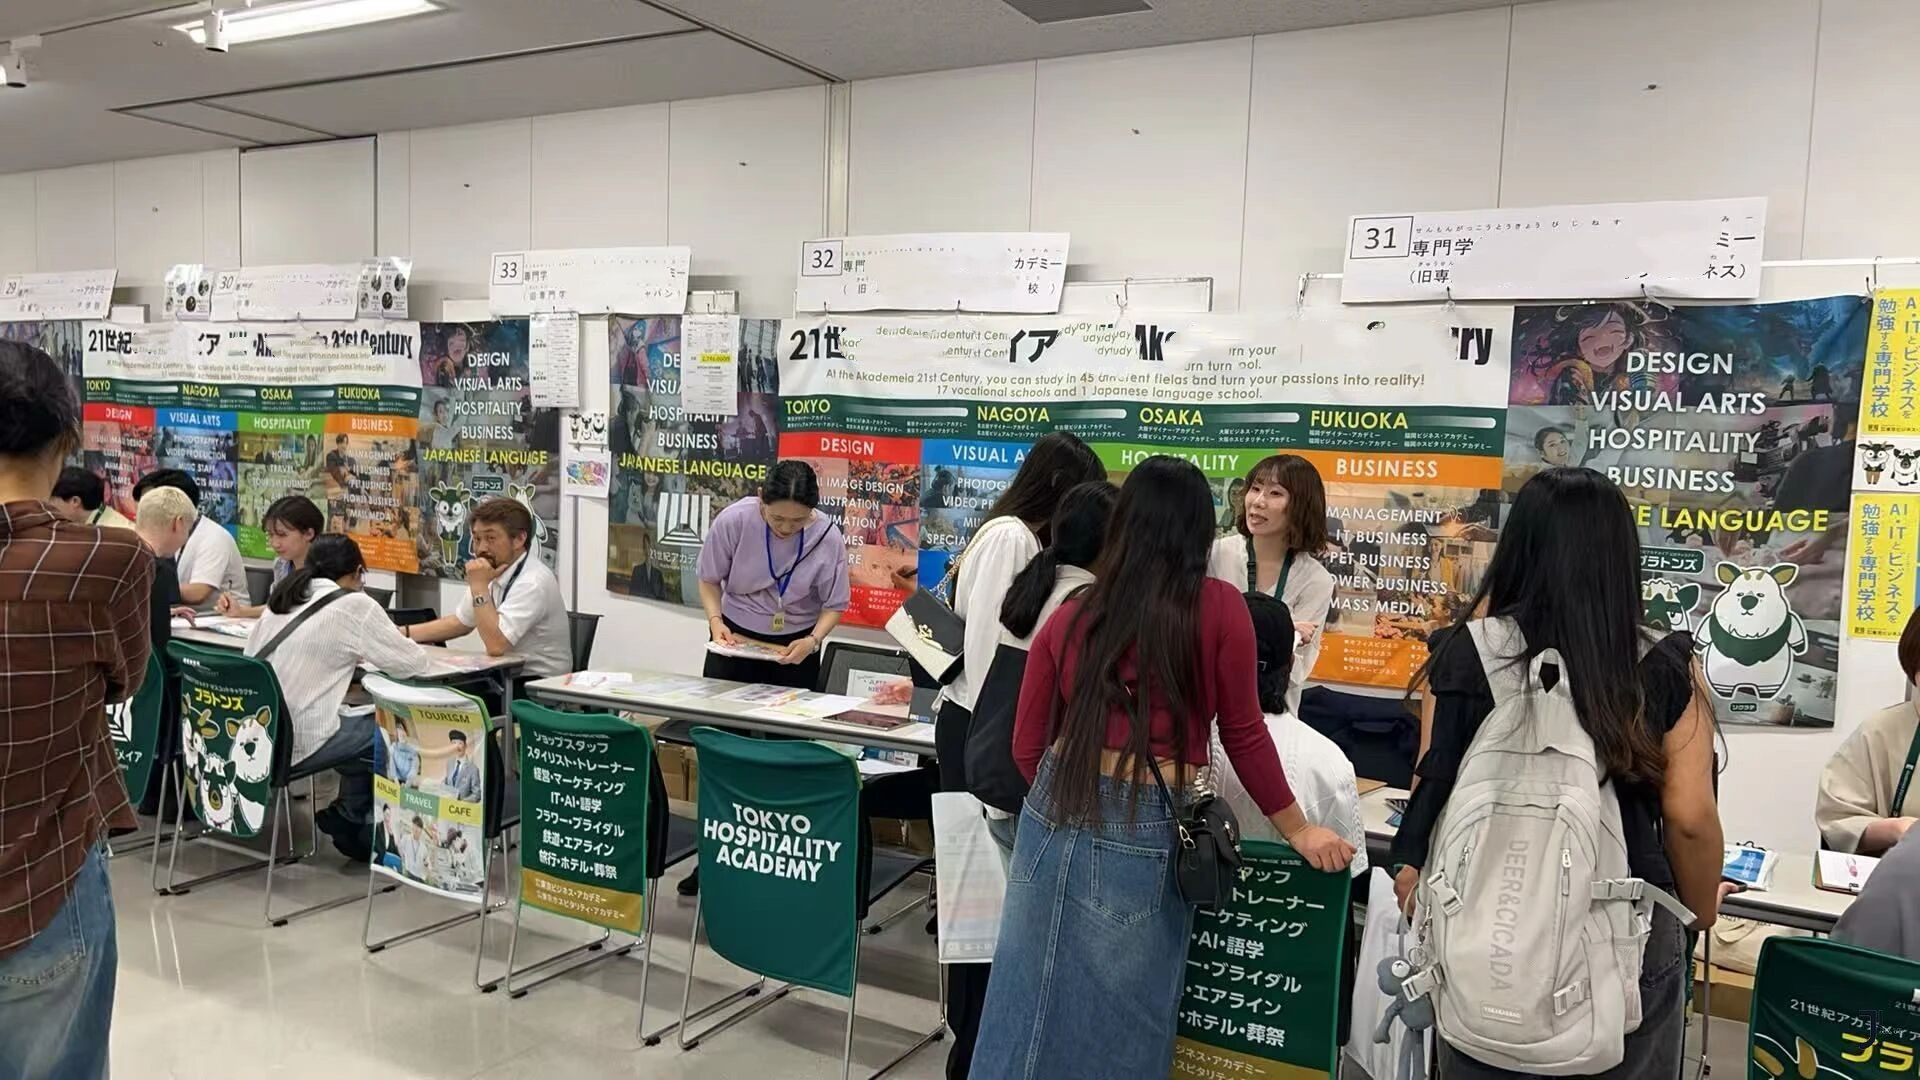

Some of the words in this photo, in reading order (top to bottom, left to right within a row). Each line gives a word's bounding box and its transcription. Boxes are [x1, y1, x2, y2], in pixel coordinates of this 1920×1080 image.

[1364, 227, 1398, 250] 31
[1411, 238, 1475, 257] 専門学
[811, 249, 834, 269] 32
[1014, 257, 1063, 270] カデミー
[500, 262, 518, 279] 33
[5, 282, 17, 295] 29
[219, 276, 234, 290] 30
[467, 352, 510, 368] DESIGN
[1626, 352, 1733, 376] DESIGN
[1870, 299, 1897, 418] 勉強する専門学校
[86, 380, 111, 392] TOKYO
[453, 377, 494, 392] VISUAL
[496, 377, 523, 392] ARTS
[839, 370, 854, 381] the
[856, 371, 914, 383] Akademeia
[916, 372, 938, 384] 21st
[940, 373, 983, 385] Century,
[986, 375, 1008, 386] you
[1010, 375, 1032, 385] can
[1035, 373, 1064, 386] study
[1066, 372, 1076, 384] in
[1079, 373, 1095, 384] 45
[1221, 375, 1246, 386] turn
[1249, 375, 1278, 387] your
[1281, 374, 1339, 388] passions
[1343, 374, 1370, 387] into
[1374, 374, 1426, 388] reality!
[183, 384, 220, 398] NAGOYA
[261, 388, 294, 401] OSAKA
[338, 387, 381, 401] FUKUOKA
[937, 385, 948, 395] 17
[951, 386, 1008, 397] vocational
[1010, 387, 1051, 398] schools
[1054, 387, 1077, 398] and
[1092, 387, 1149, 399] Japanese
[1152, 388, 1214, 401] language
[1217, 389, 1263, 400] school.
[454, 400, 523, 416] HOSPITALITY
[785, 399, 832, 415] TOKYO
[1591, 390, 1691, 413] VISUAL
[1695, 391, 1767, 415] ARTS
[170, 412, 201, 425] VISUAL
[202, 415, 221, 426] ARTS
[976, 405, 1050, 423] NAGOYA
[1139, 406, 1205, 427] OSAKA
[1310, 409, 1409, 431] FUKUOKA
[254, 417, 312, 431] HOSPITALITY
[351, 418, 394, 432] BUSINESS
[461, 424, 514, 440] BUSINESS
[657, 432, 718, 449] BUSINESS
[820, 437, 876, 456] DESIGN
[1588, 427, 1763, 454] HOSPITALITY
[423, 448, 482, 464] JAPANESE
[484, 449, 548, 465] LANGUAGE
[952, 444, 1009, 464] VISUAL
[684, 460, 767, 480] LANGUAGE
[1336, 458, 1438, 479] BUSINESS
[827, 477, 863, 491] IMAGE
[866, 479, 904, 495] DESIGN
[1608, 466, 1736, 494] BUSINESS
[942, 496, 978, 509] VIDEO
[1326, 507, 1443, 524] MANAGEMENT
[1660, 507, 1830, 532] LANGUAGE
[926, 533, 970, 546] SPECIA
[1336, 530, 1350, 542] IT
[1356, 531, 1428, 546] BUSINESS
[1330, 552, 1354, 565] PET
[1359, 553, 1431, 570] BUSINESS
[1640, 555, 1698, 571] プラトンズ
[1856, 503, 1880, 622] 勉強する専門学校
[1376, 577, 1448, 595] BUSINESS
[1330, 599, 1370, 612] MASS
[1375, 600, 1426, 616] MEDIA
[418, 709, 471, 724] TOURISM
[533, 730, 609, 754] ショップスタッフ
[527, 745, 635, 774] スタイリスト・トレーナー
[533, 766, 627, 795] 経営・マーケティング
[405, 793, 433, 809] TRAVEL
[551, 791, 602, 814] IT・AI・語学
[448, 804, 472, 817] CAFE
[733, 802, 811, 834] TOKYO
[536, 808, 625, 838] フラワー・ブライダル
[542, 828, 615, 857] 鉄道・エアライン
[703, 818, 842, 862] HOSPITALITY
[538, 848, 618, 880] 旅行・ホテル・葬祭
[716, 844, 823, 882] ACADEMY
[1489, 840, 1530, 991] DEER&CICADA
